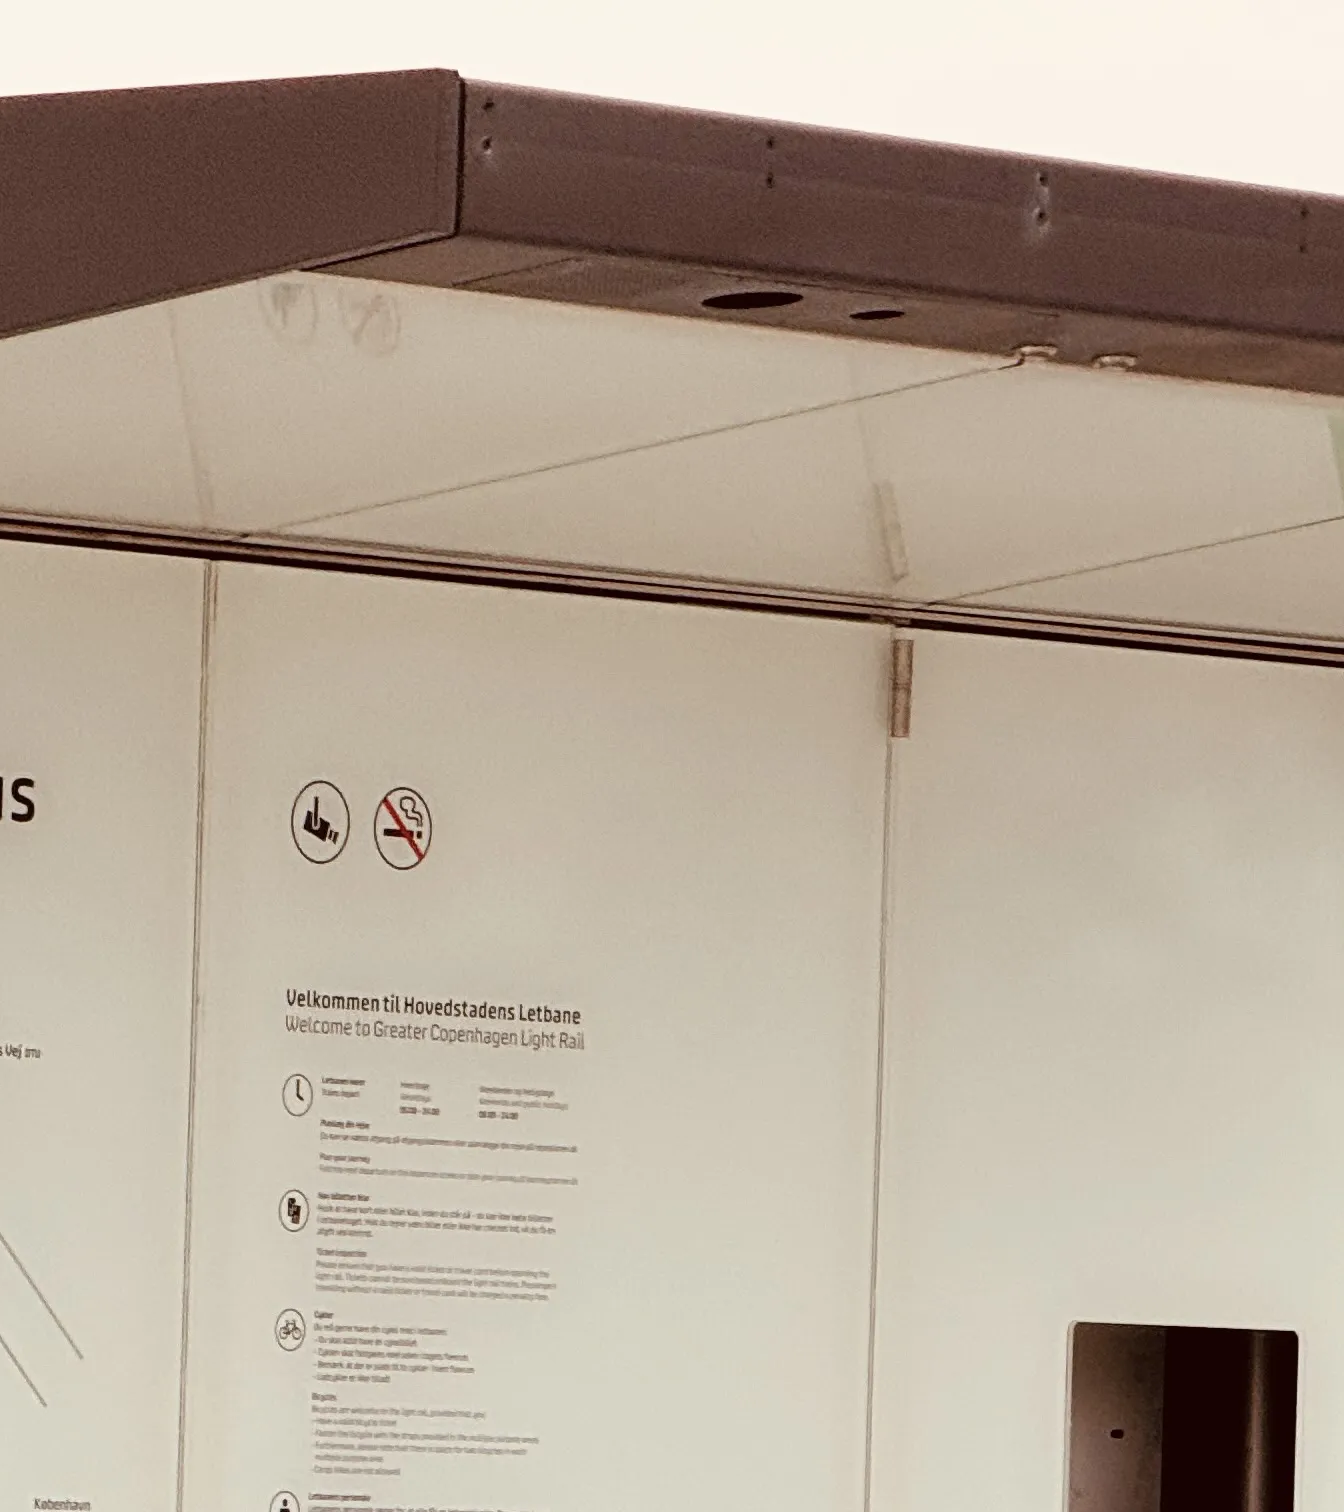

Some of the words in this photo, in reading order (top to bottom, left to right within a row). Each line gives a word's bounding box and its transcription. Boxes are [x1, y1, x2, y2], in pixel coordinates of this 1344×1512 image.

[286, 988, 379, 1013] Velkommen
[384, 994, 400, 1013] til
[404, 997, 514, 1021] Hovedstadens
[520, 1004, 580, 1024] Letbane
[286, 1015, 352, 1036] Welcome
[355, 1021, 370, 1037] to
[374, 1021, 428, 1040] Greater
[430, 1024, 517, 1048] Copenhagen
[520, 1029, 556, 1051] Light
[559, 1032, 584, 1050] Rail
[5, 1044, 22, 1059] Vej
